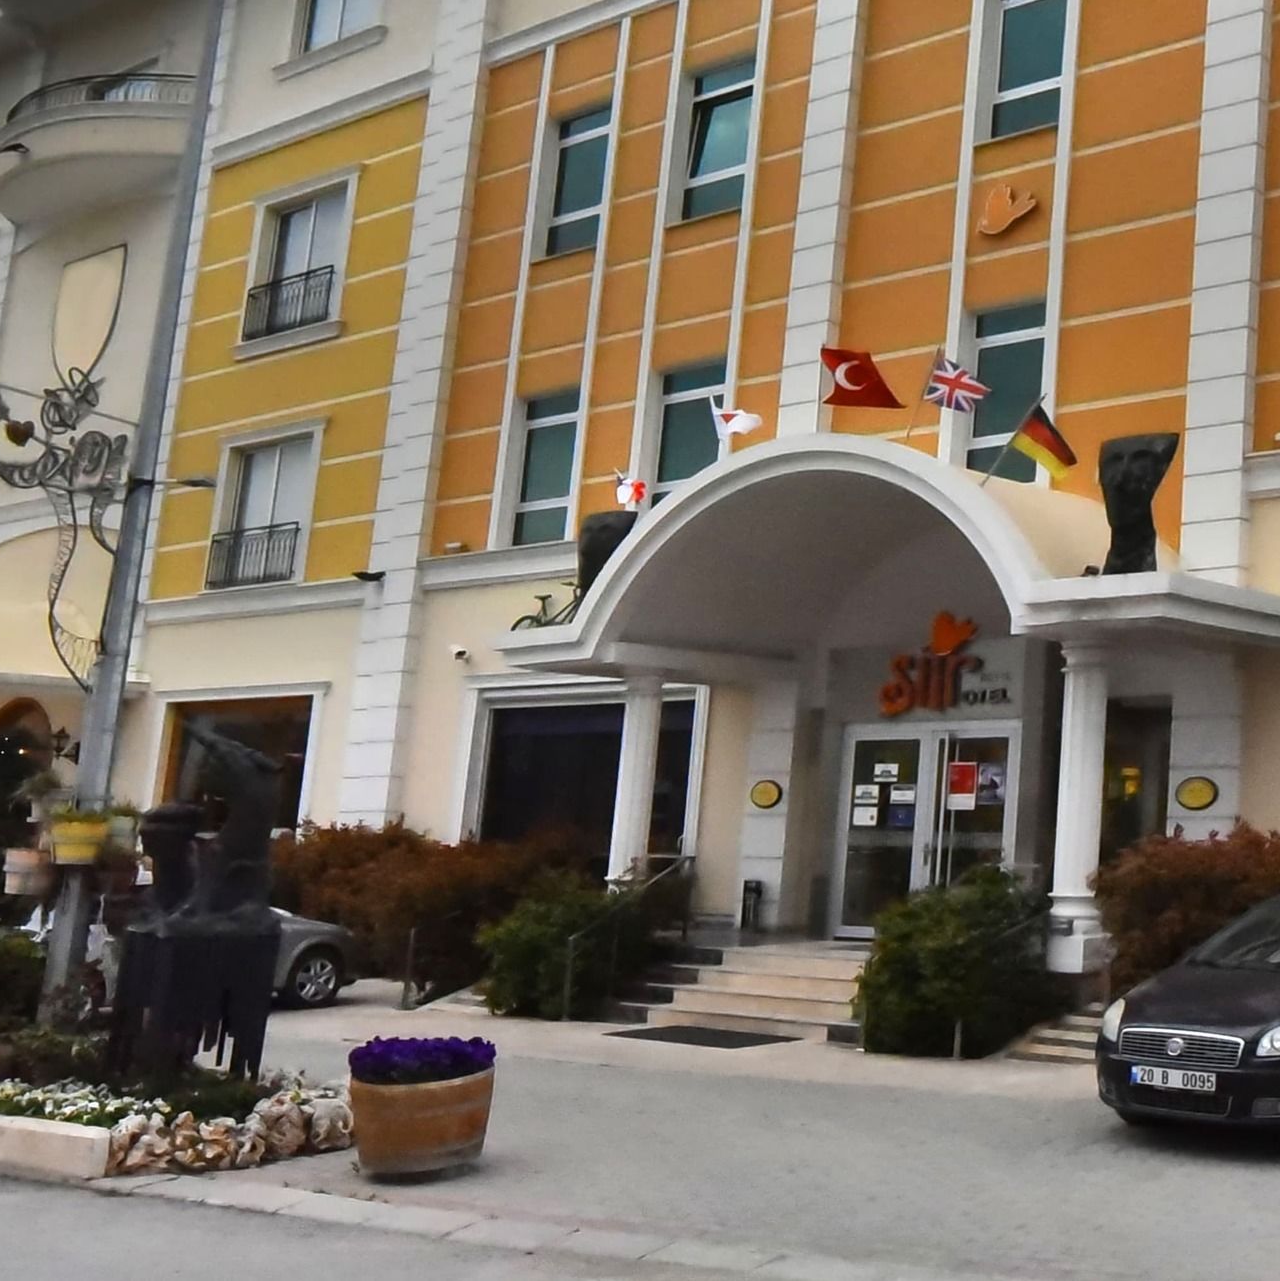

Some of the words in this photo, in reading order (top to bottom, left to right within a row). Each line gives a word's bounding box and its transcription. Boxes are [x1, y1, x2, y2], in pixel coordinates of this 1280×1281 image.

[1140, 1068, 1154, 1083] 20
[1161, 1070, 1169, 1085] B
[1182, 1072, 1214, 1090] 0095
